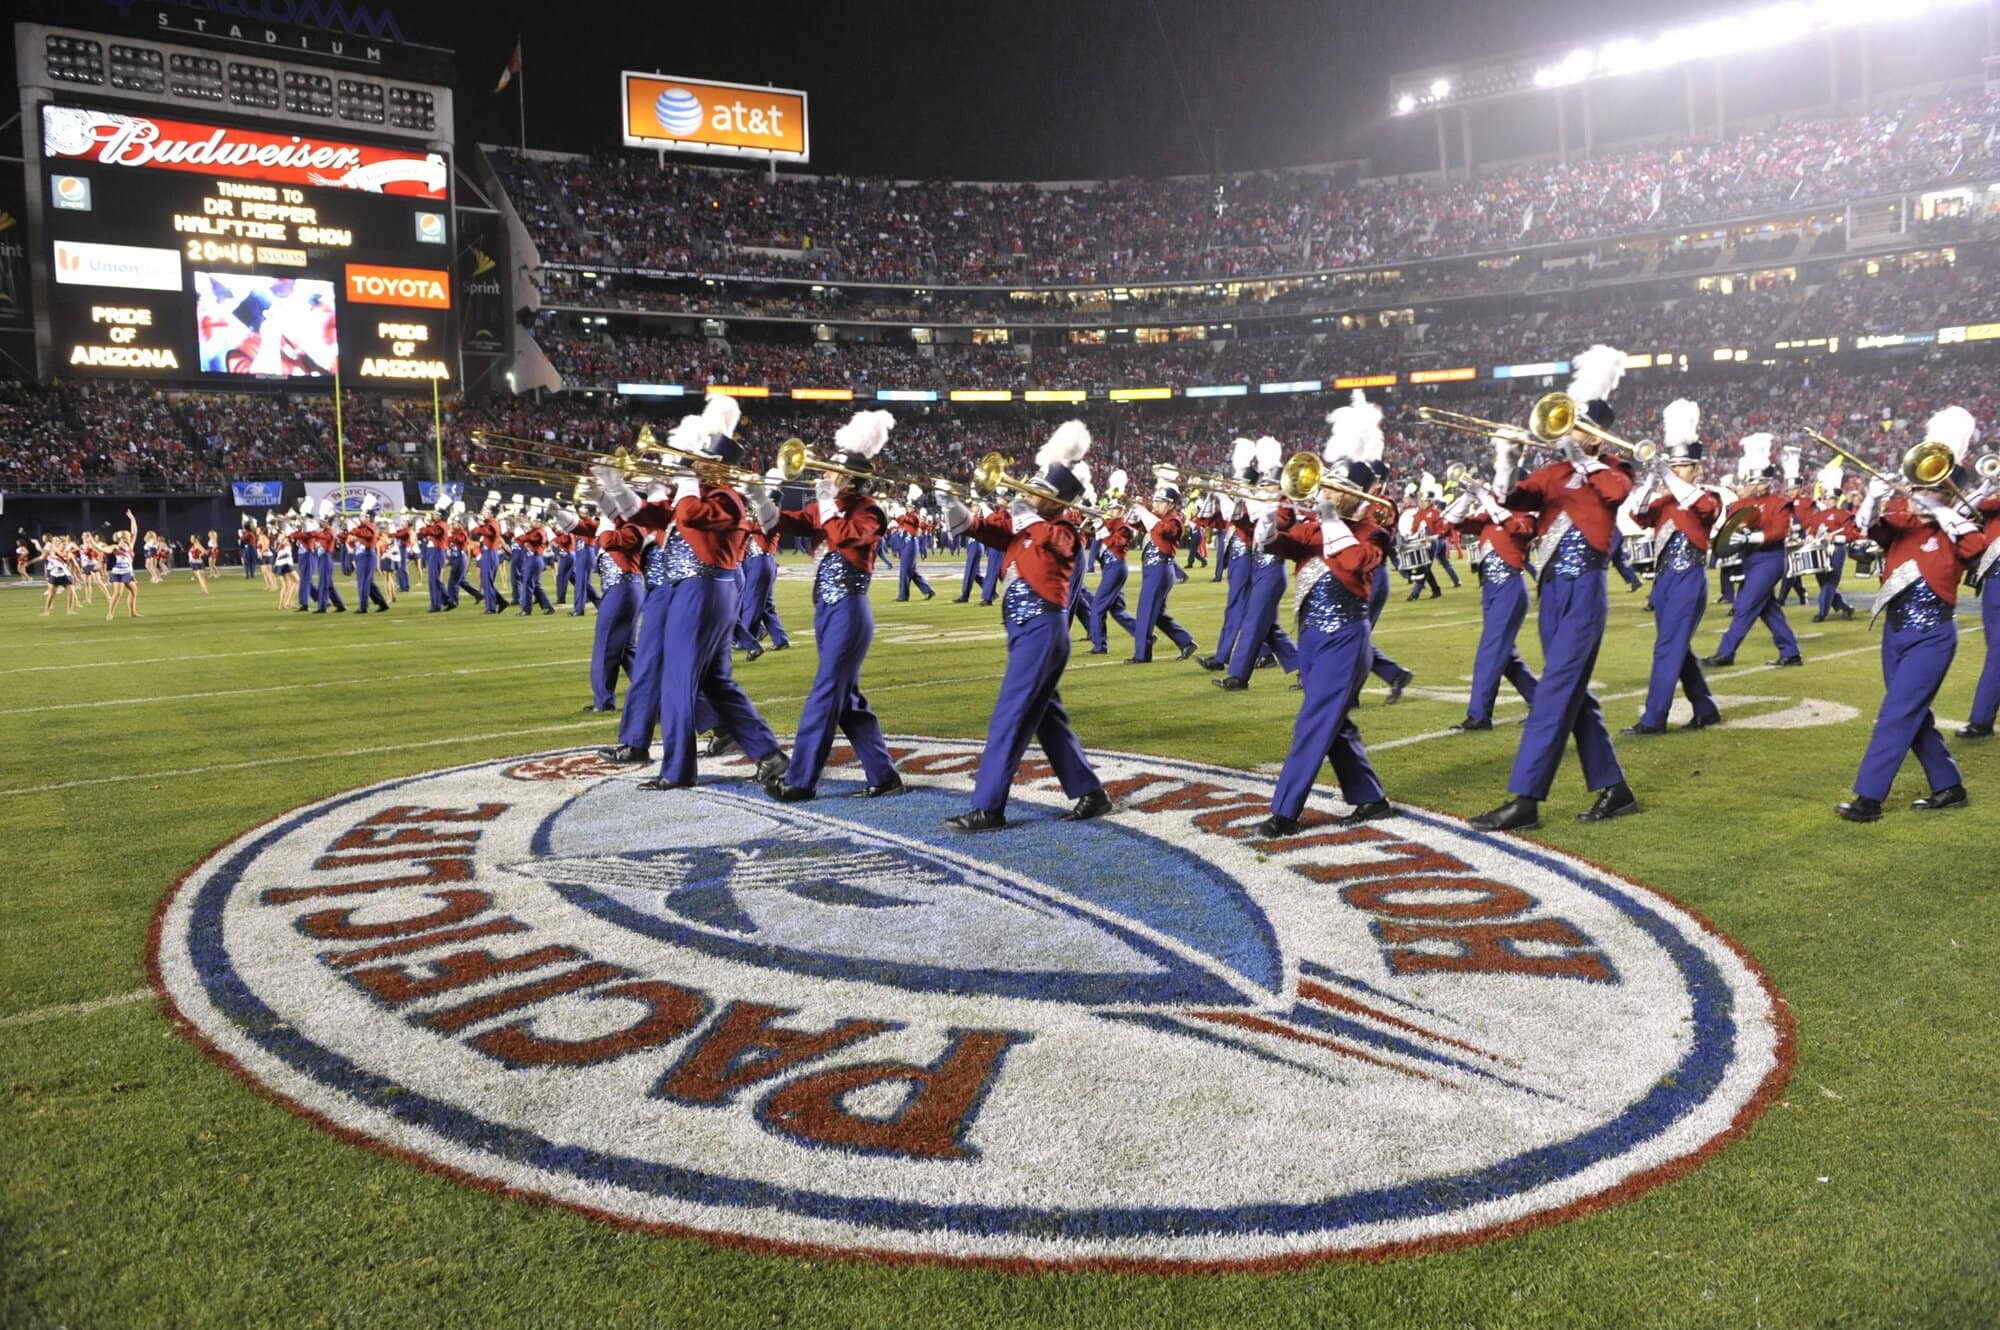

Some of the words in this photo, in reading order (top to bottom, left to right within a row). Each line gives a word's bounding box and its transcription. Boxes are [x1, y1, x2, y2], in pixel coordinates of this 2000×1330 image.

[158, 12, 381, 60] STADIUM
[711, 101, 784, 137] at&t
[88, 117, 360, 169] Budweiser
[217, 182, 277, 202] THANKS
[282, 188, 304, 204] TO
[204, 198, 234, 216] DR
[241, 202, 317, 225] PEPPER
[174, 215, 286, 241] HALFTIME
[298, 227, 352, 247] SHOW
[351, 276, 446, 300] TOYOTA
[463, 280, 501, 297] Sprint
[92, 306, 152, 325] PRIDE
[110, 327, 137, 344] OF
[378, 323, 428, 341] PRIDE
[70, 346, 179, 369] ARIZONA
[393, 342, 416, 357] OF
[360, 358, 450, 379] ARIZONA
[331, 488, 362, 501] PAIFIC
[261, 801, 511, 906] LIFE
[294, 888, 1034, 1161] PACIFIC
